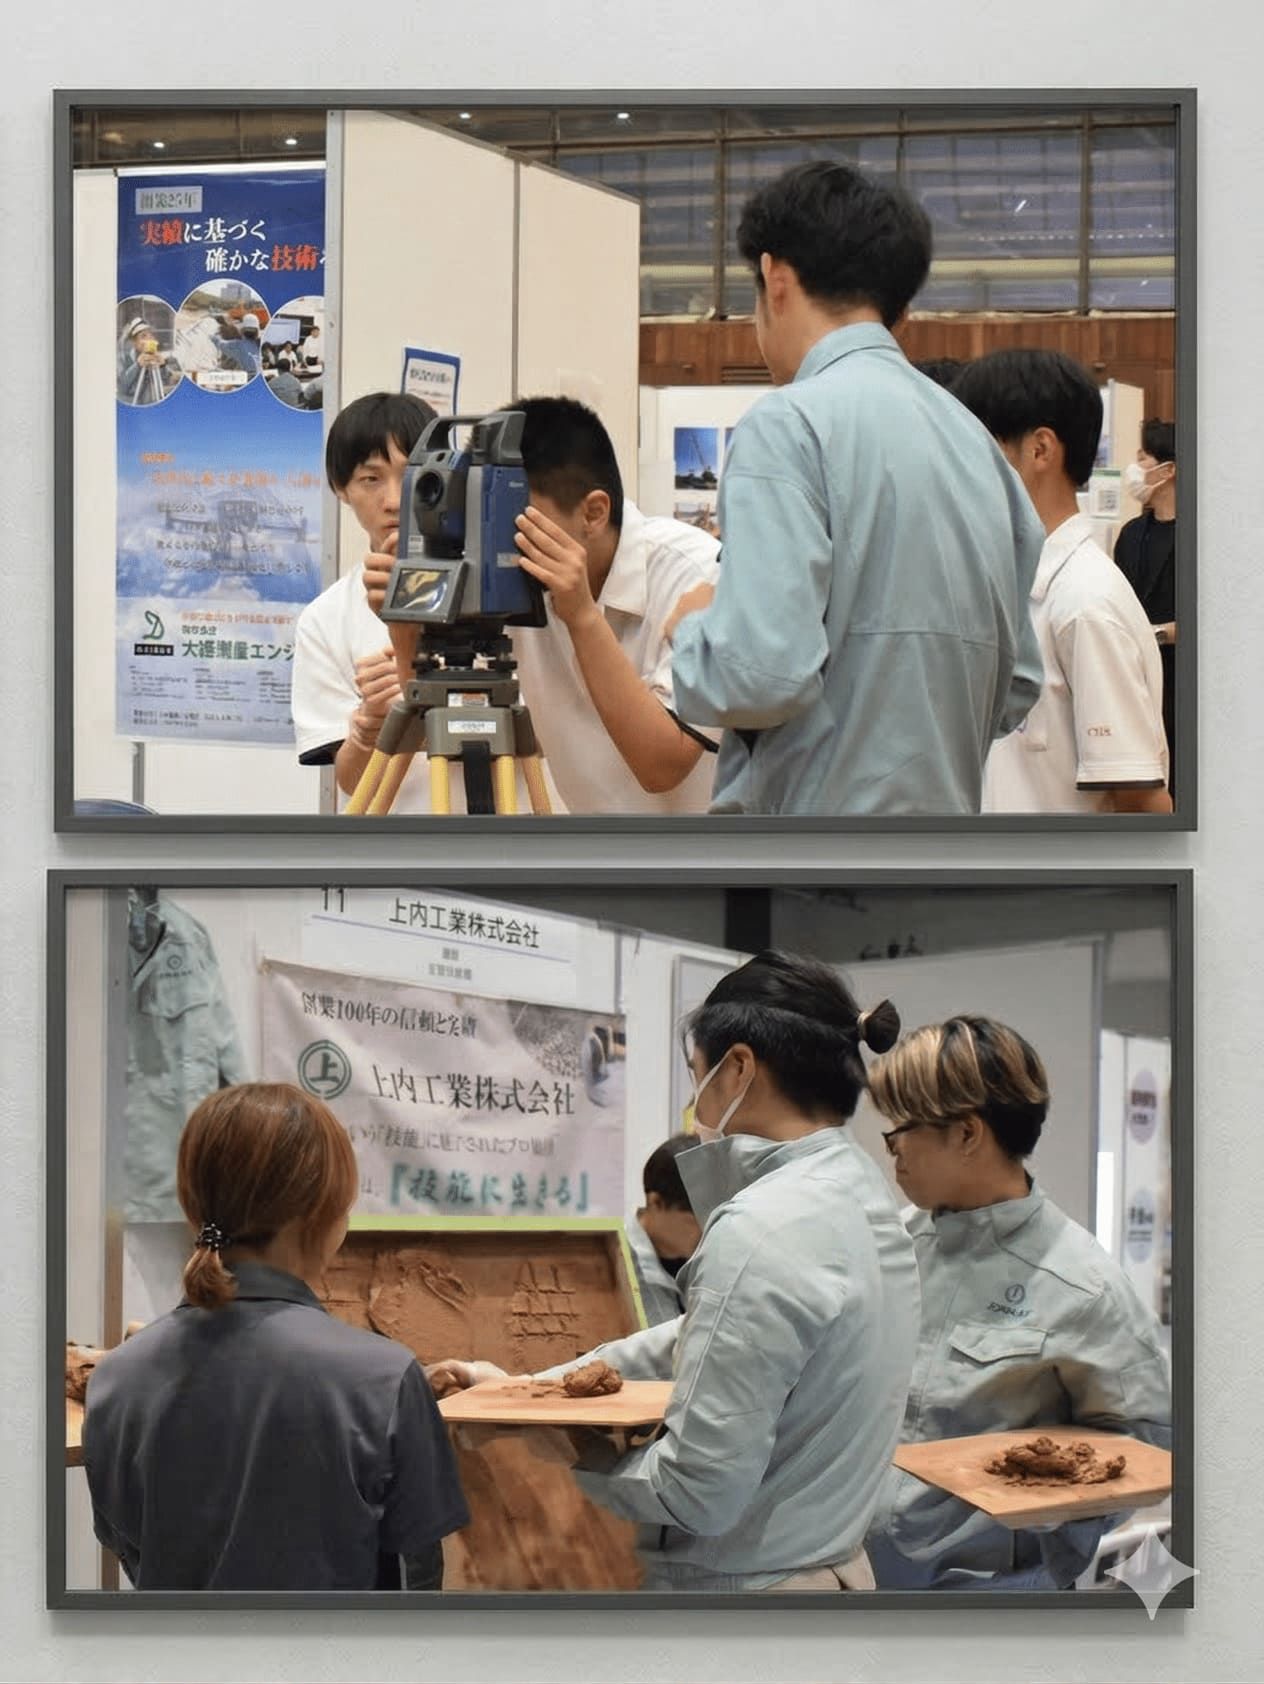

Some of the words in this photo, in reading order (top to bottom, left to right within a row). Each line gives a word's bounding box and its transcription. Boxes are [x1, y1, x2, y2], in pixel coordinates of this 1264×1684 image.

[140, 216, 267, 245] 実績に基づく
[389, 897, 540, 949] 上内工業株式会社
[372, 1063, 576, 1117] 上内工業株式会社
